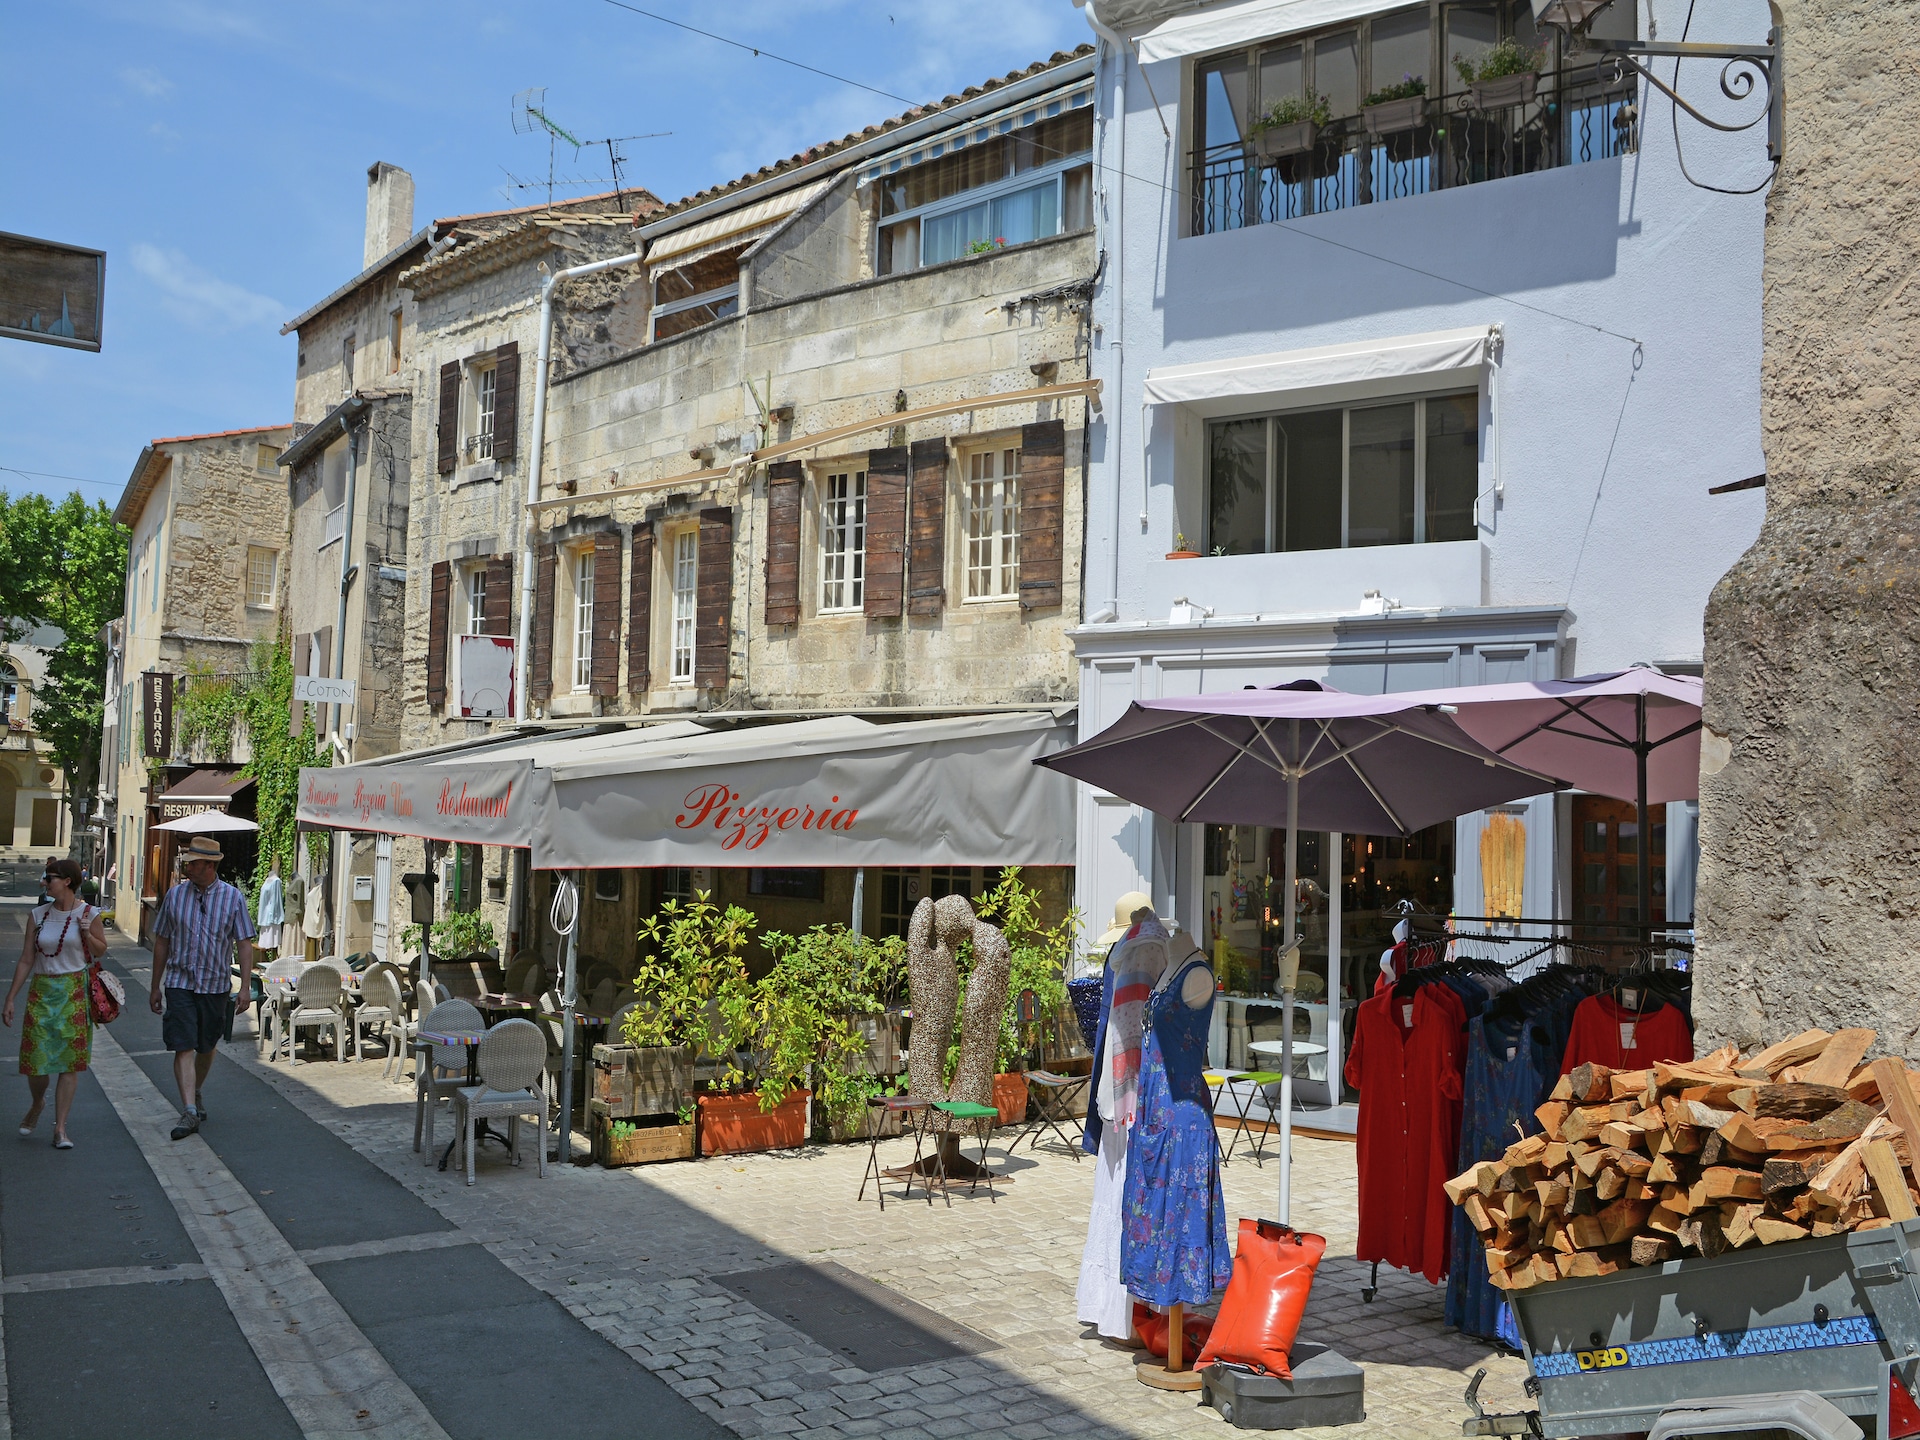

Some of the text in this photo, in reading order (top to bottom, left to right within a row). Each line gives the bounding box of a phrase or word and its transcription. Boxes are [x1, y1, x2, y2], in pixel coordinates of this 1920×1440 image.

[153, 677, 163, 753] RESTAURANT
[352, 778, 387, 824] Pizzeria
[437, 777, 513, 818] Restaurant
[675, 783, 859, 851] Pizzeria
[1577, 1347, 1628, 1370] DBD
